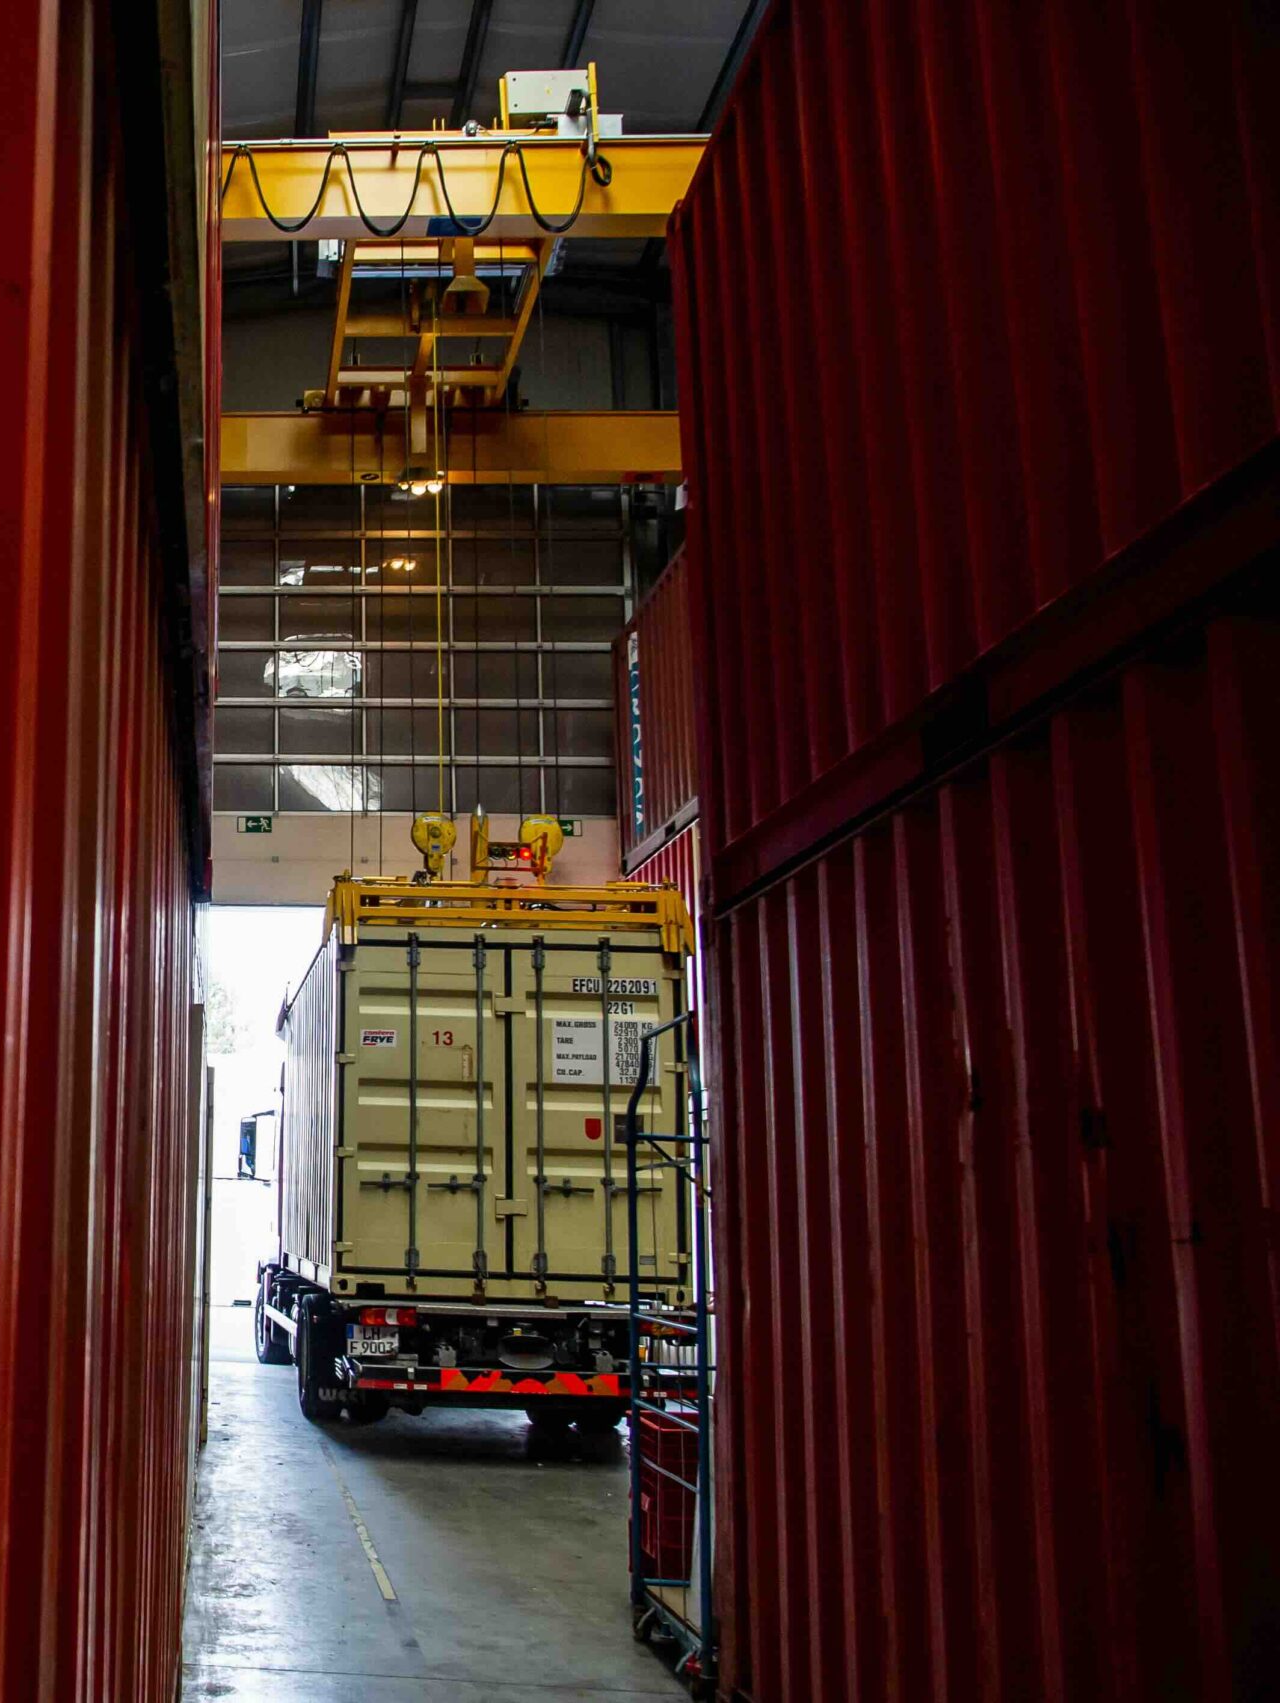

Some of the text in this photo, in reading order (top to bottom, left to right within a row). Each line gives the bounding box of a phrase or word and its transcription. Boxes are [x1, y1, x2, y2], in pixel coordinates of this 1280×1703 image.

[572, 979, 600, 993] EFCU
[607, 1002, 634, 1015] 22G1
[363, 1035, 394, 1043] FRYE
[432, 1030, 454, 1046] 13
[363, 1328, 380, 1340] LH
